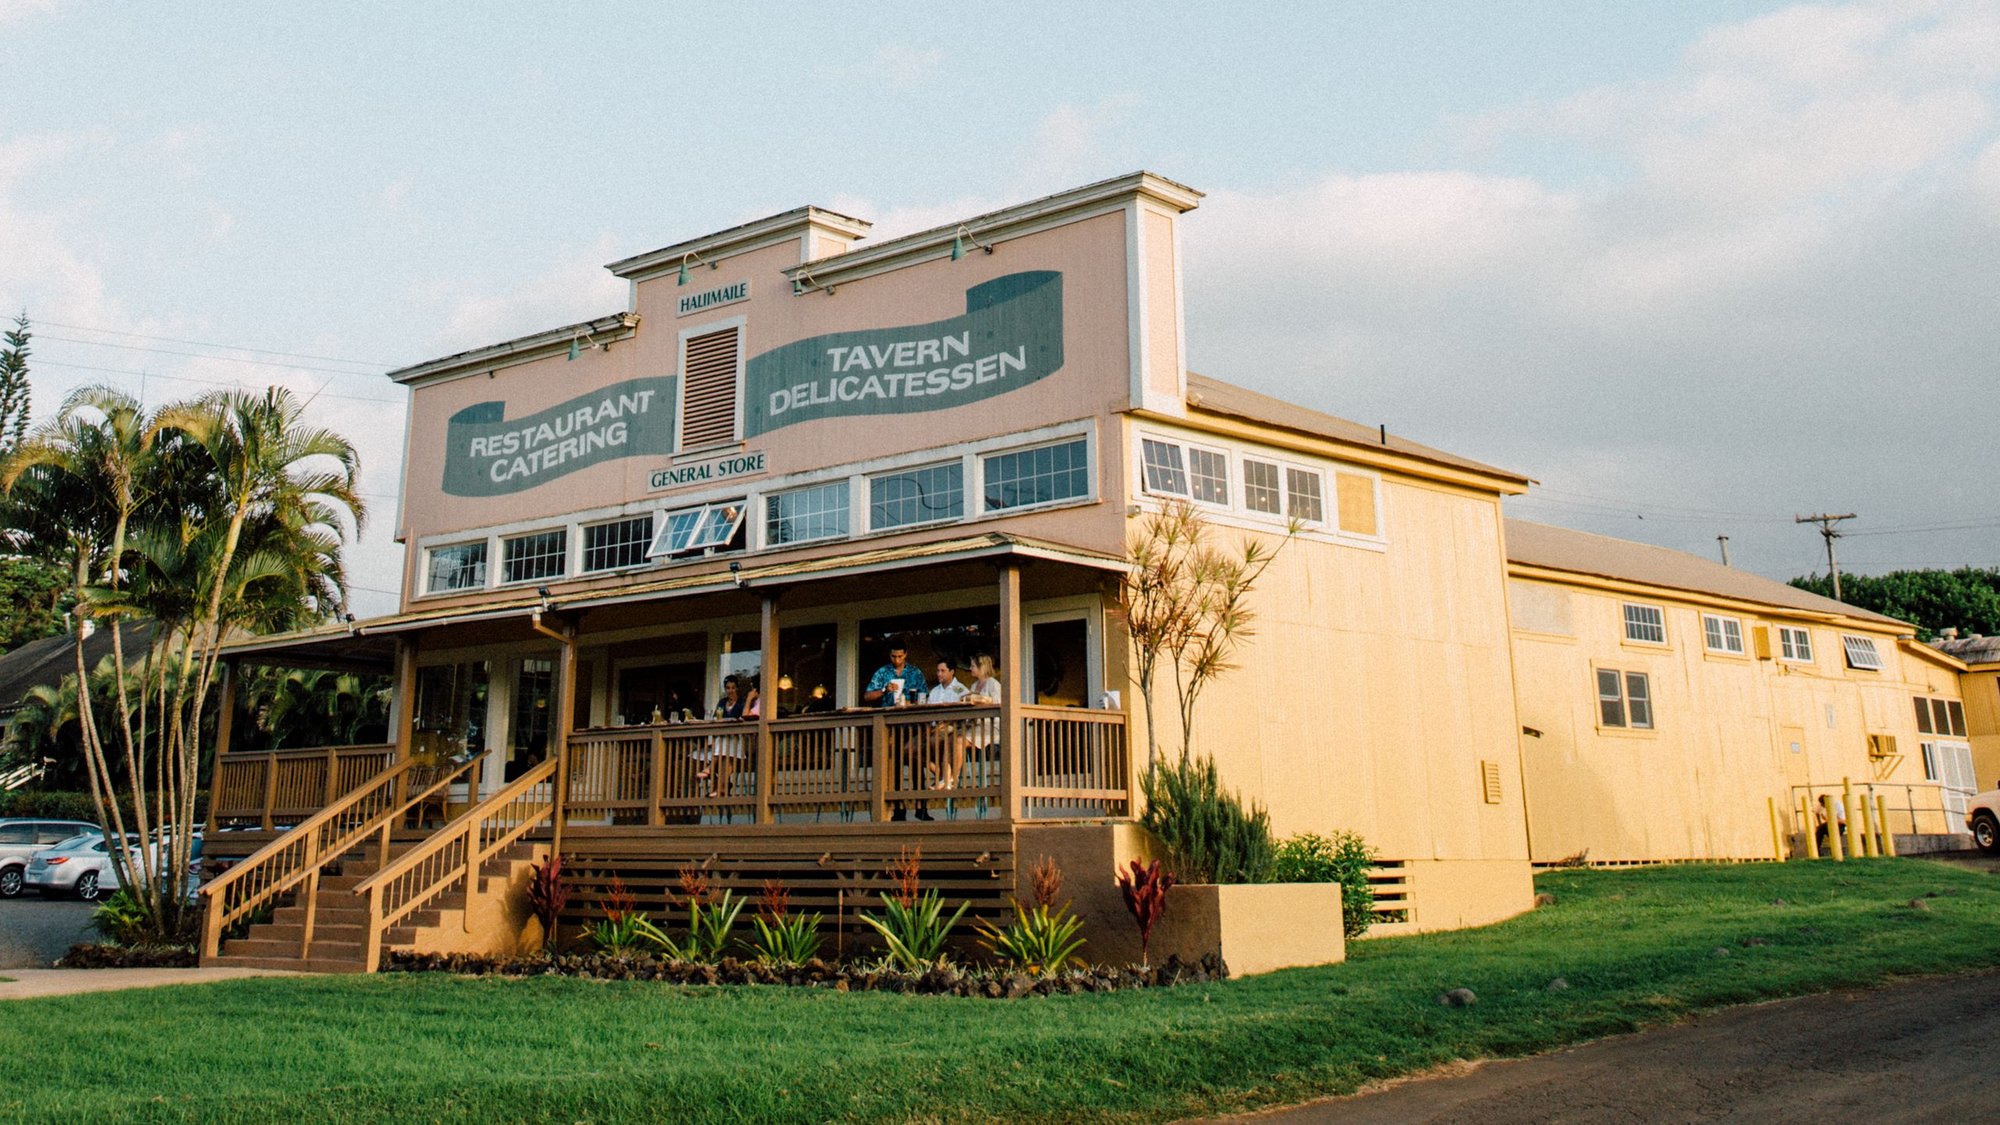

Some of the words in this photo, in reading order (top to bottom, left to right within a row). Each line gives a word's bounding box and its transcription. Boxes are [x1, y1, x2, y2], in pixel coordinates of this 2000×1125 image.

[769, 345, 1027, 416] DELICATESSEN
[827, 330, 970, 372] TAVERN
[469, 390, 655, 457] RESTAURANT
[490, 422, 628, 482] CATERING
[651, 464, 712, 488] GENERAL
[718, 454, 765, 476] STORE
